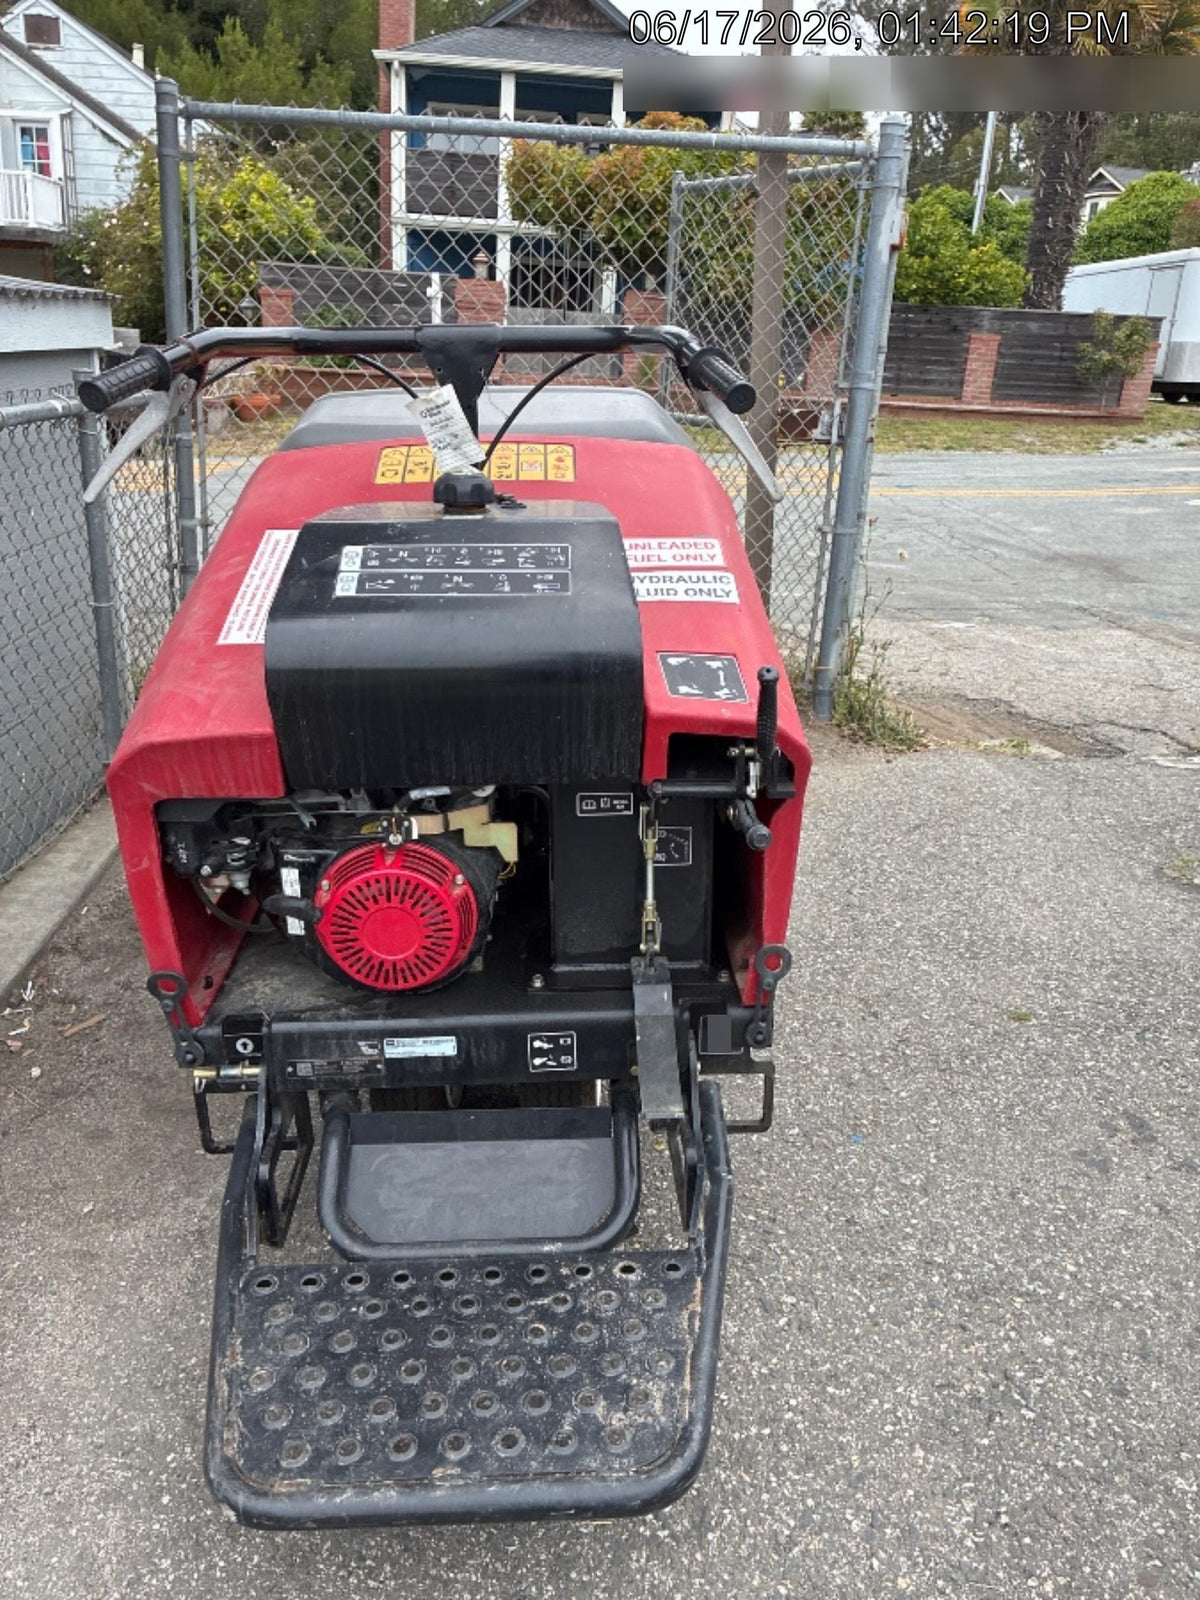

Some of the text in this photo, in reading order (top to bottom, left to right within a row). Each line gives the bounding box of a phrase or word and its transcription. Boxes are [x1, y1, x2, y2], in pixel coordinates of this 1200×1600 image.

[672, 554, 717, 562] ONLY
[635, 588, 732, 598] LUID ONLY
